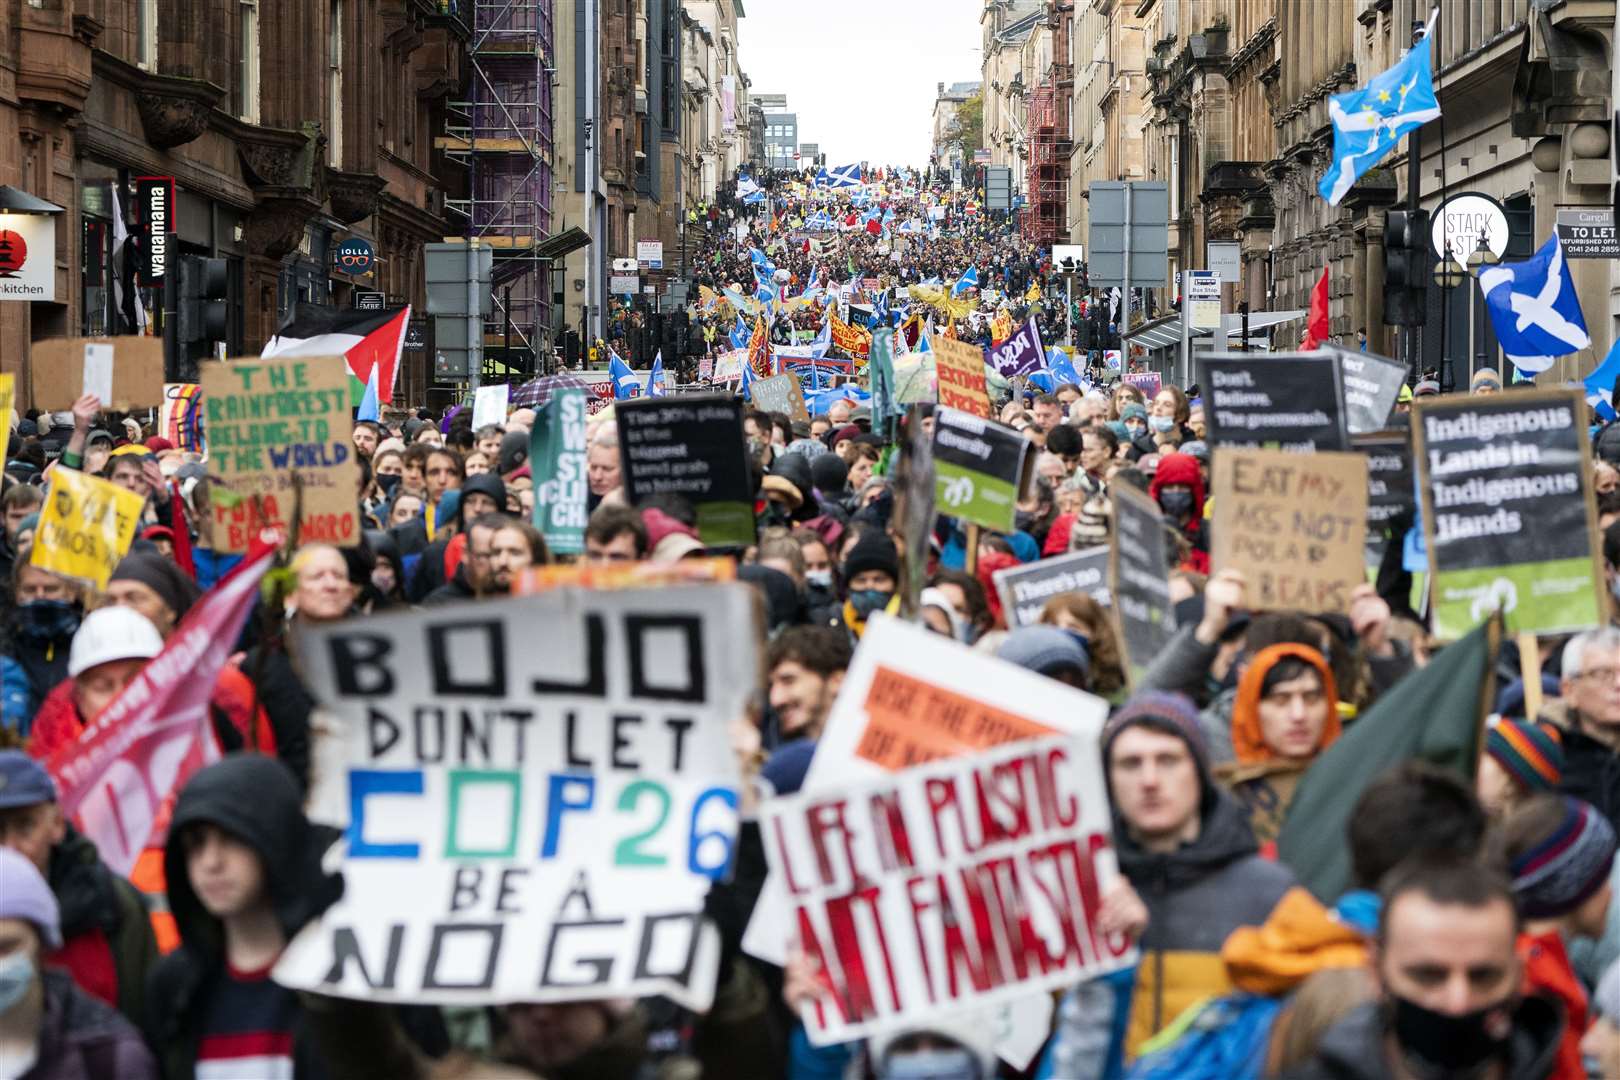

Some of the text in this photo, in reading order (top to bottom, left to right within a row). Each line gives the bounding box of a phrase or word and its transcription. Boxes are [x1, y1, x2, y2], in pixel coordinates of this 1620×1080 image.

[1446, 213, 1493, 234] STACK
[1571, 227, 1616, 238] TO LET
[1567, 245, 1584, 253] 0141
[1584, 245, 1600, 253] 248
[232, 363, 309, 391] THE
[1215, 410, 1247, 427] The
[1425, 406, 1572, 443] Indigenous
[211, 442, 349, 473] THE WORLD
[1428, 445, 1511, 476] Lands
[1511, 441, 1540, 465] in
[1232, 457, 1295, 495] EAT
[1297, 471, 1344, 500] MY
[1431, 472, 1579, 509] Indigenous
[1293, 510, 1356, 544] NOT
[1436, 508, 1523, 542] Hands
[327, 612, 706, 702] BOJO
[563, 709, 697, 773] LET
[925, 748, 1079, 859] PLASTIC
[344, 769, 740, 882] COP26
[449, 868, 596, 917] BE A
[324, 911, 700, 991] NO GO
